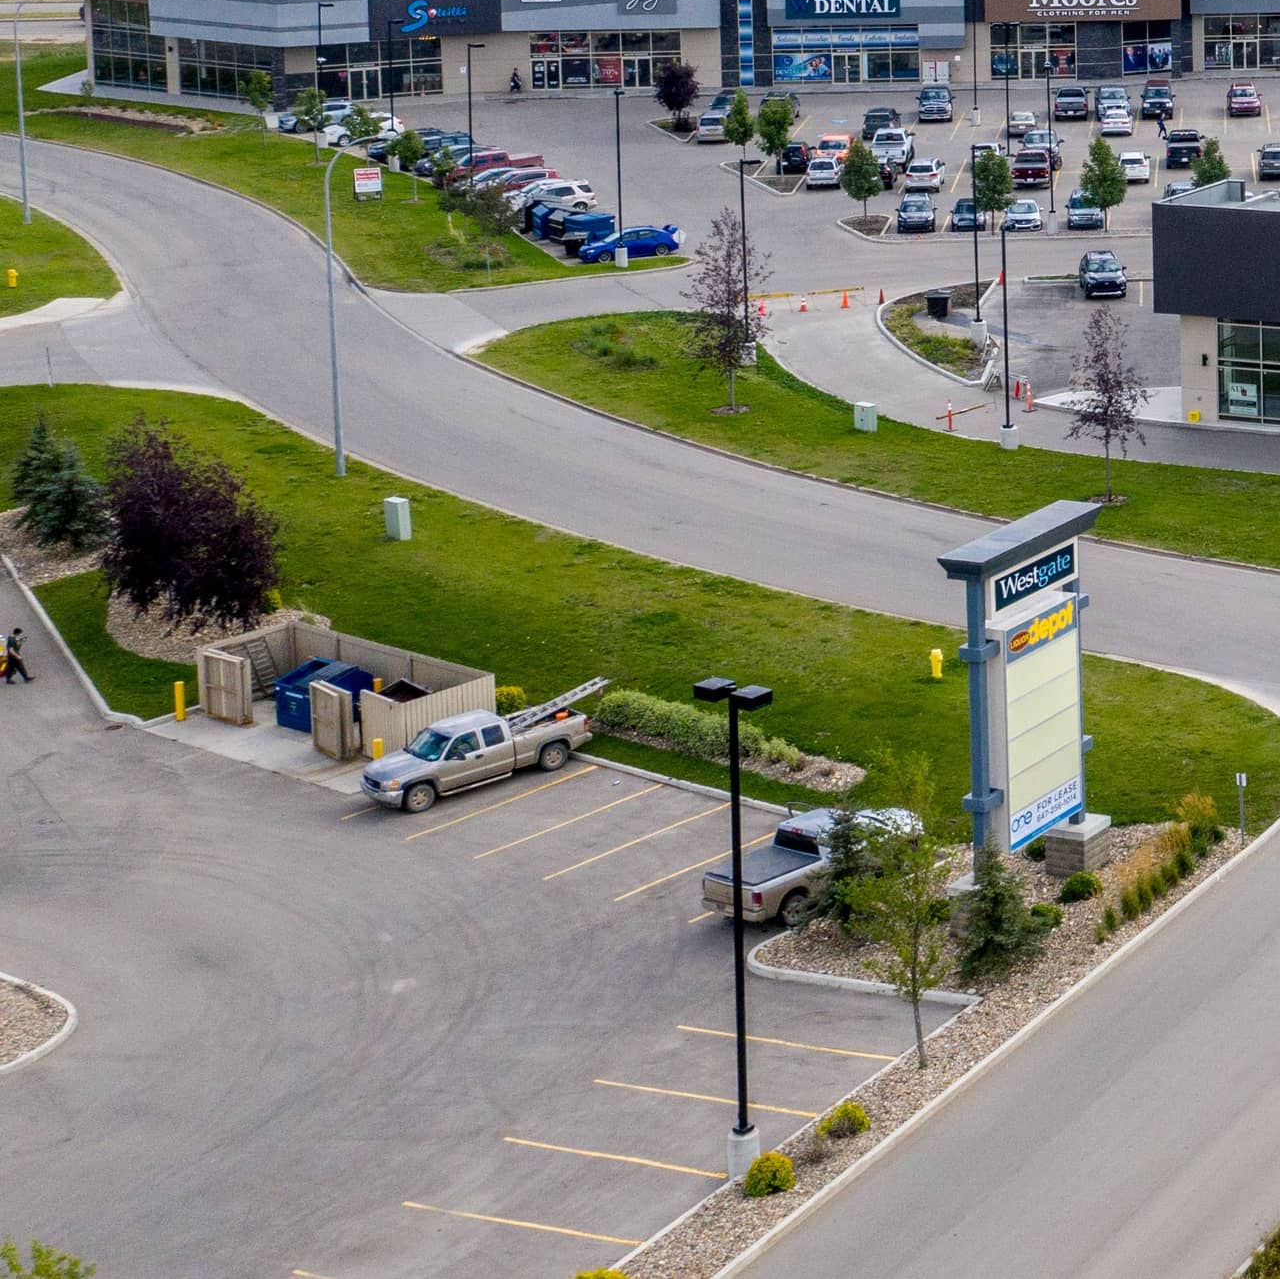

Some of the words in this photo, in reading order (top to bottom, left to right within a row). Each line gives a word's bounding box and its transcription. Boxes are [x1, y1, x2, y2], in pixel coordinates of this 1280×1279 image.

[1000, 554, 1071, 599] Westgate
[1028, 600, 1073, 645] depot
[1036, 796, 1053, 812] FOR
[1053, 780, 1078, 801] LEASE
[1012, 810, 1033, 833] one
